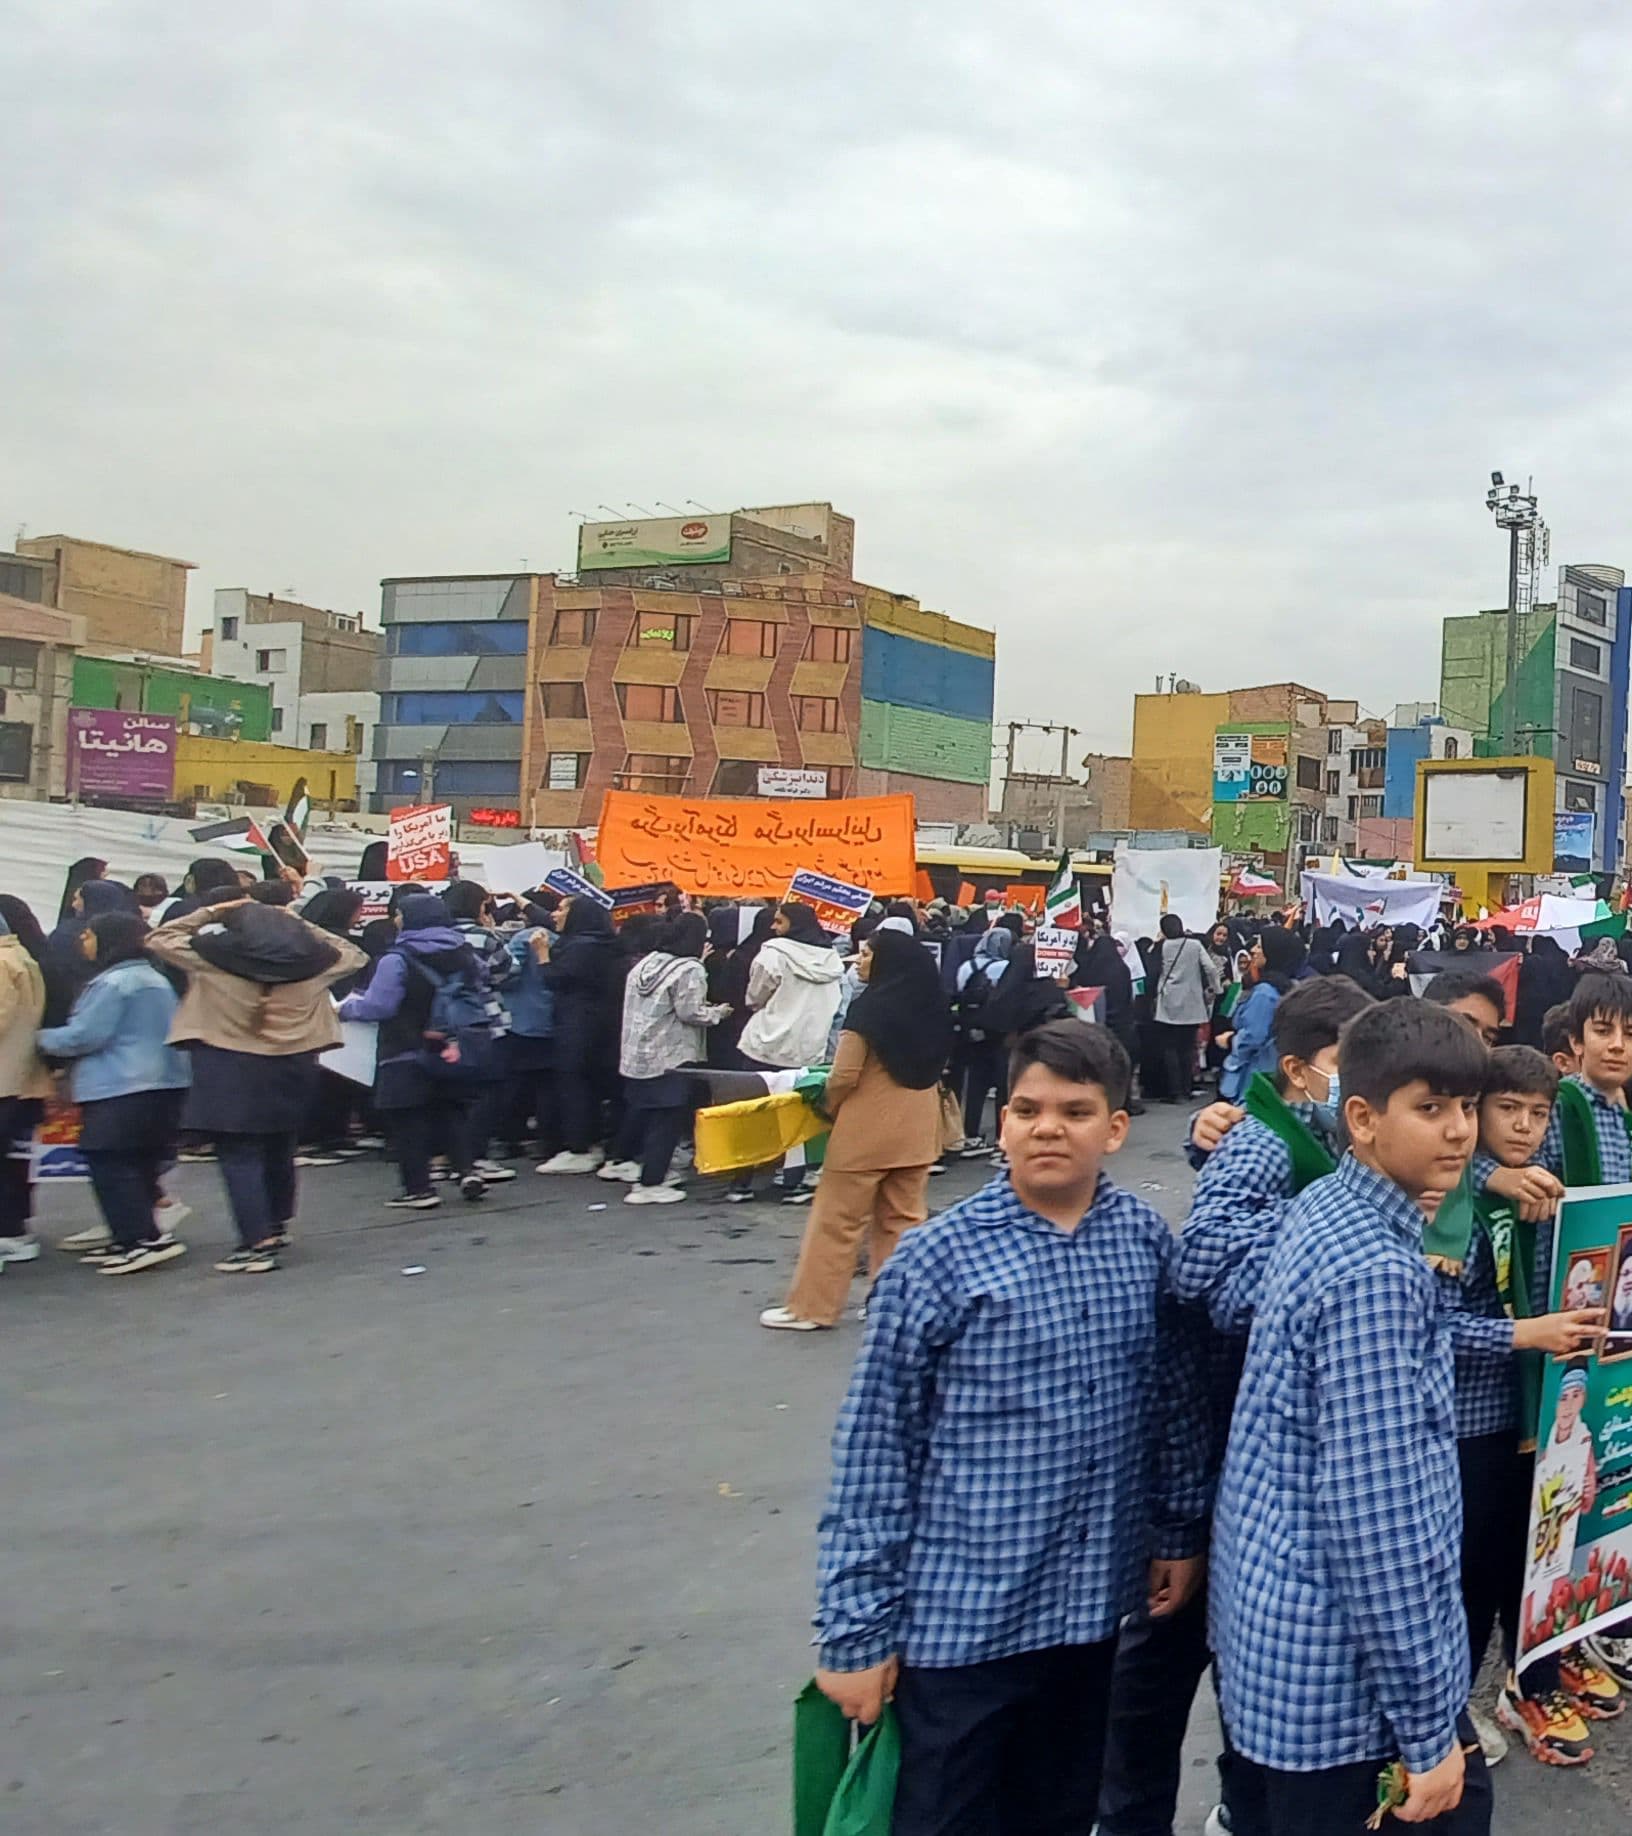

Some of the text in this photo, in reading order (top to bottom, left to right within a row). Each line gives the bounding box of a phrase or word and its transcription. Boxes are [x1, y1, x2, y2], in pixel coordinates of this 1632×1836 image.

[123, 717, 170, 730] سالن
[78, 730, 168, 758] هانیتا
[762, 770, 825, 786] دندانپزشکی
[403, 815, 432, 834] آمریکا
[394, 828, 403, 840] را
[398, 846, 446, 874] USA
[1037, 931, 1062, 946] آمریکا
